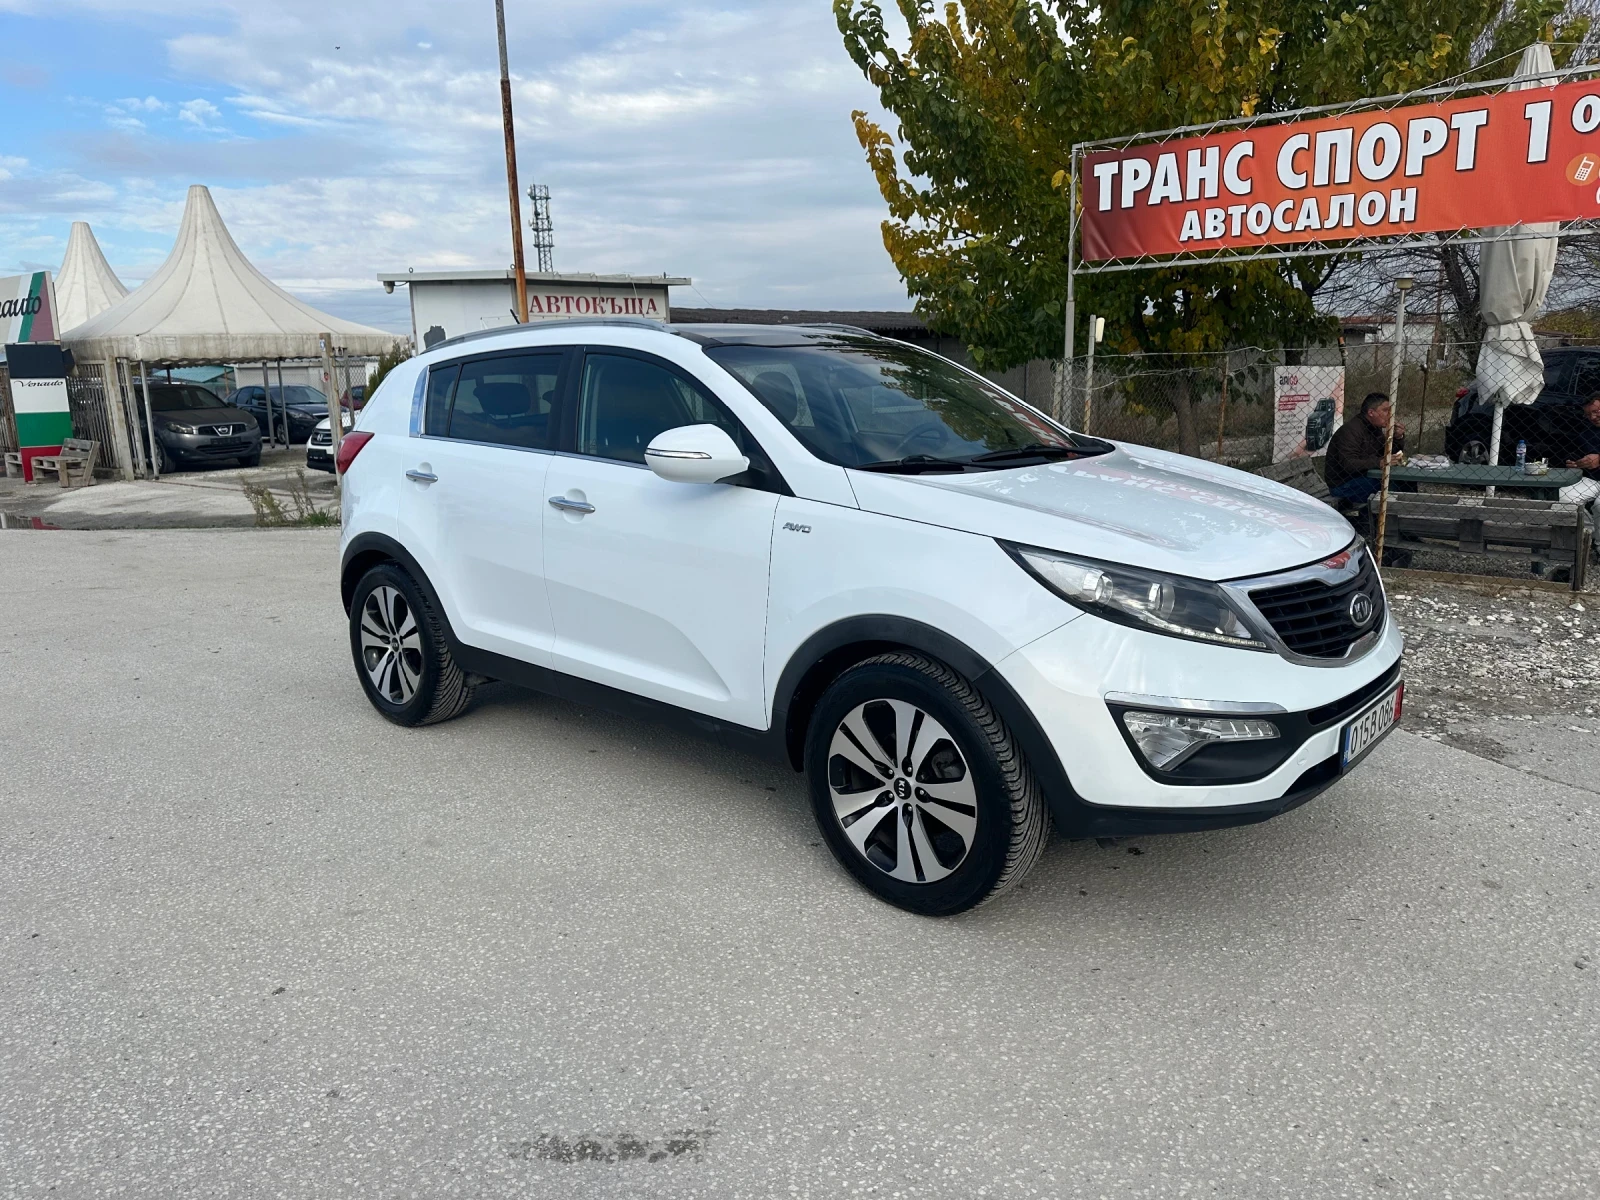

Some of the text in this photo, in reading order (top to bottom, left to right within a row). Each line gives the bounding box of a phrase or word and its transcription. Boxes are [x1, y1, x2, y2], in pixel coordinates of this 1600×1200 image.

[1093, 140, 1254, 211] ТРАНС
[1276, 109, 1488, 189] СПОРТ
[1524, 100, 1553, 163] 1
[1179, 187, 1417, 242] АВТОСАЛОН
[0, 290, 41, 317] auto
[529, 295, 659, 316] АВТОКЪЩА
[782, 522, 812, 533] AWD
